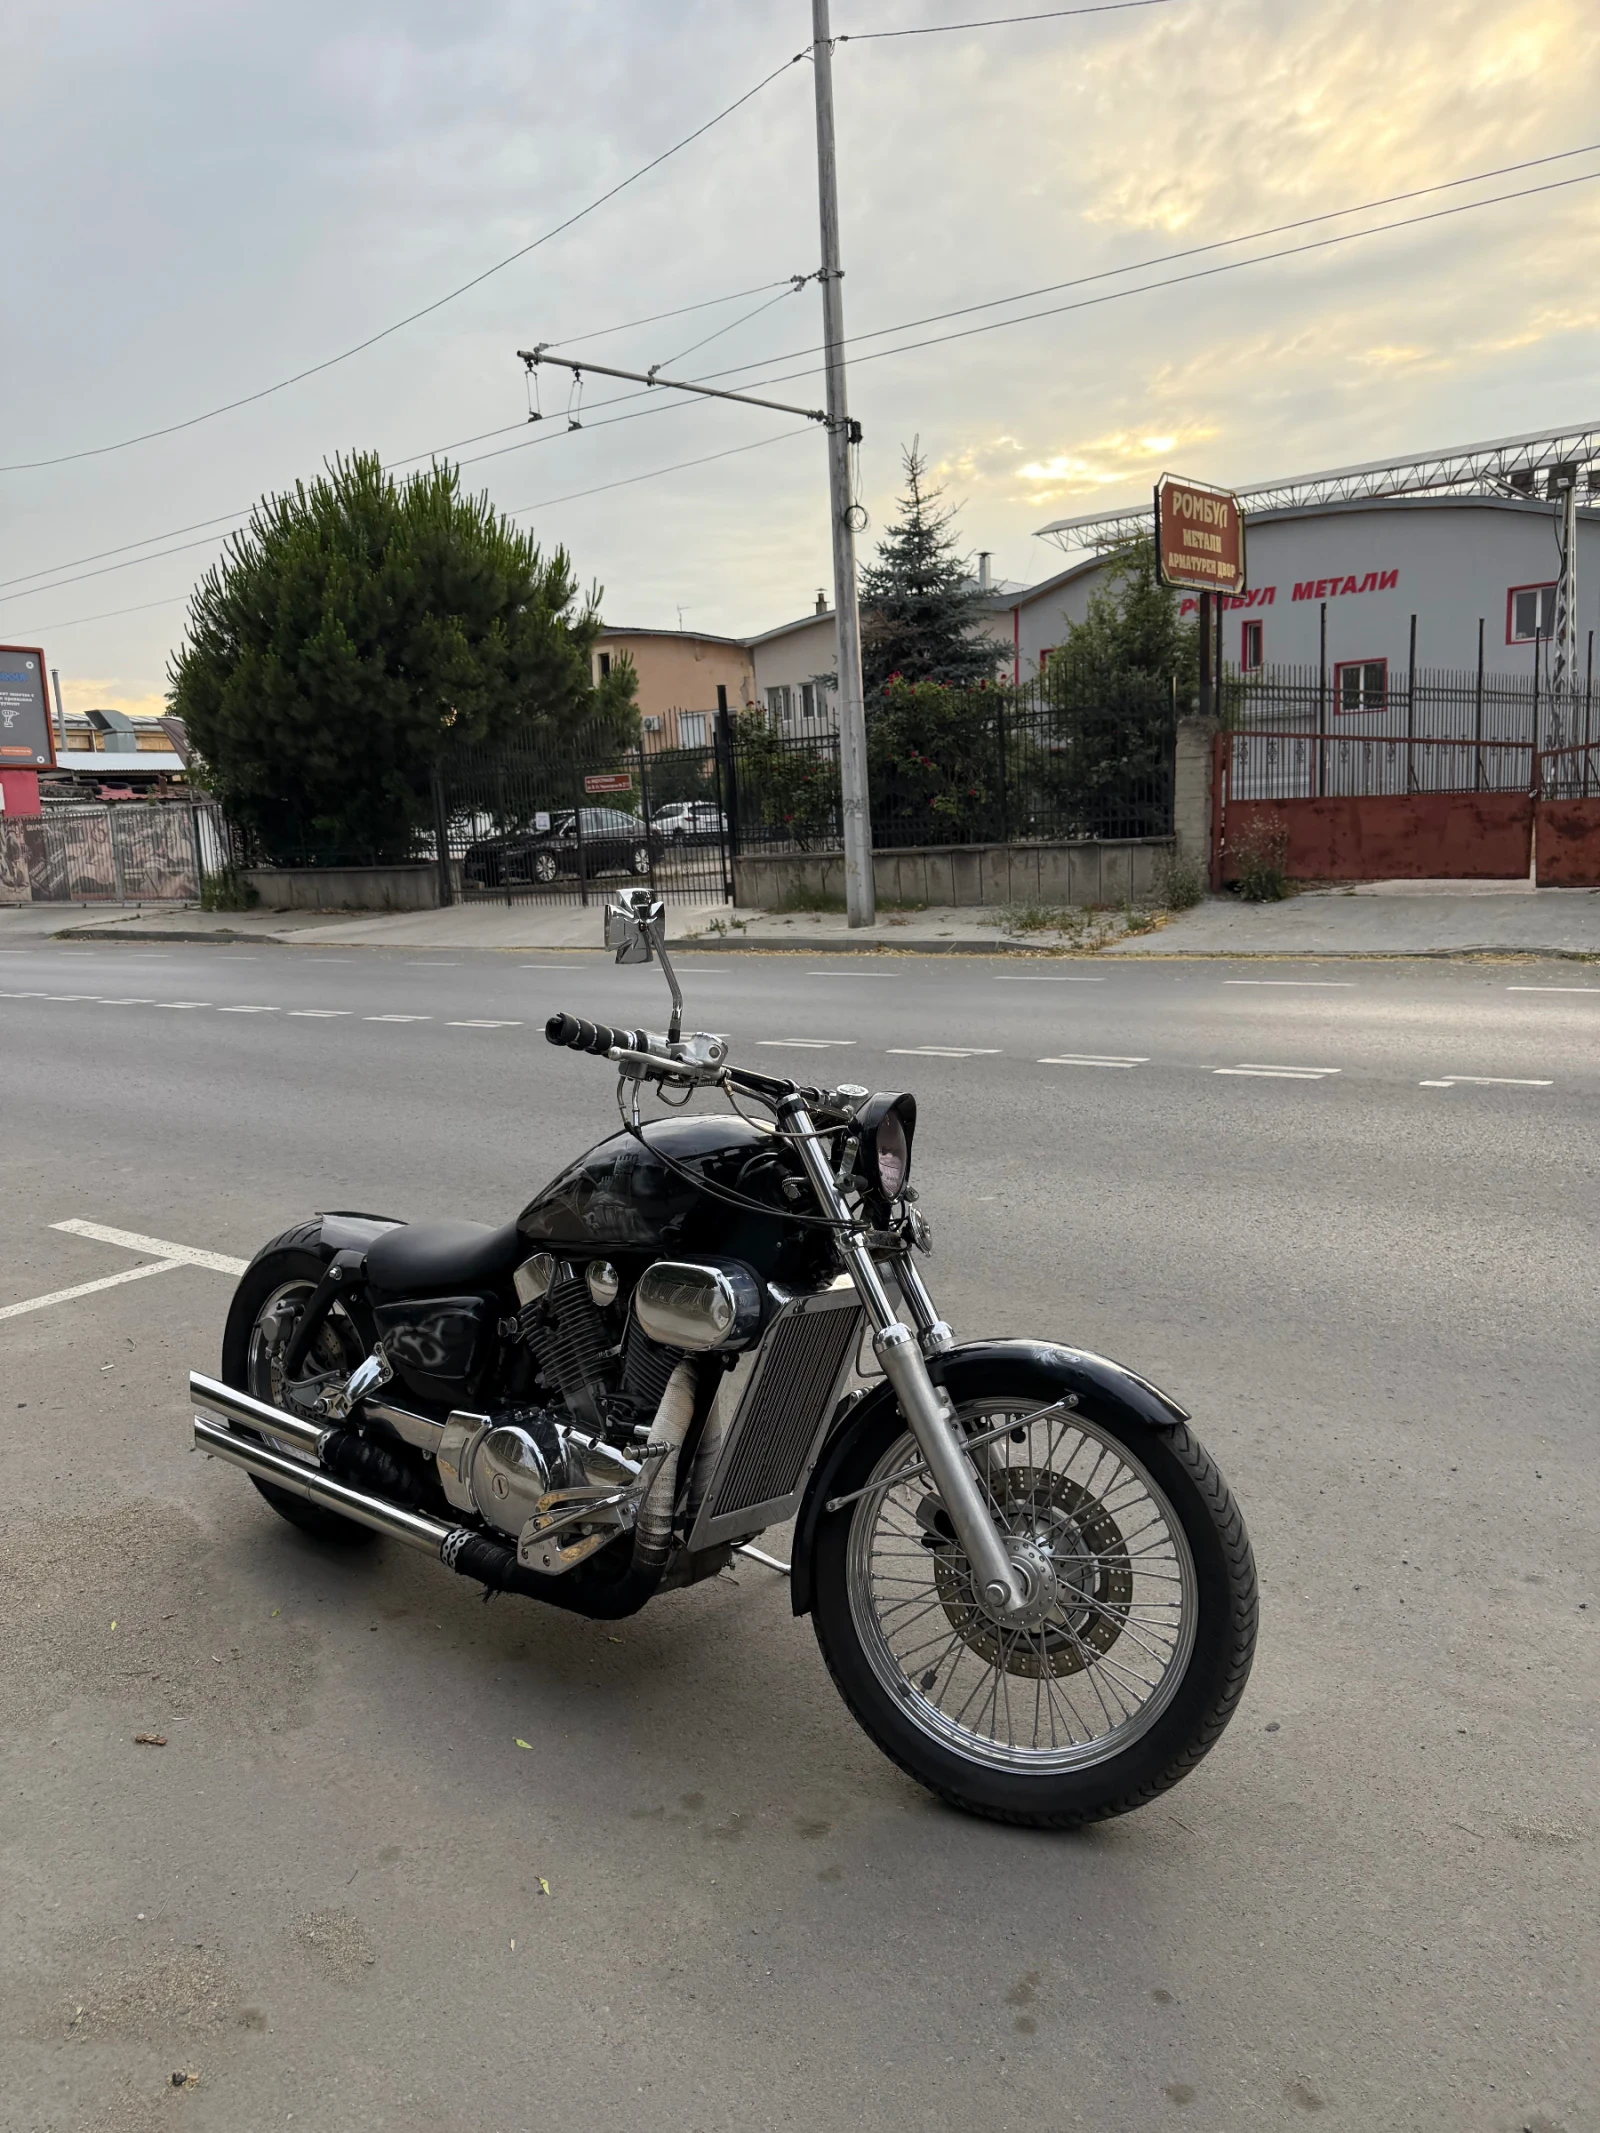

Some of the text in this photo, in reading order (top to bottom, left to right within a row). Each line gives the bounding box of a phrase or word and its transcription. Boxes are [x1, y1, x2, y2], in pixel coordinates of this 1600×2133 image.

[1172, 491, 1228, 528] РОМБУЛ
[1182, 528, 1222, 553] МЕТАЛИ
[1168, 552, 1236, 579] АРМАТУРЕН ДВОР
[1291, 569, 1399, 602] МЕТАЛИ
